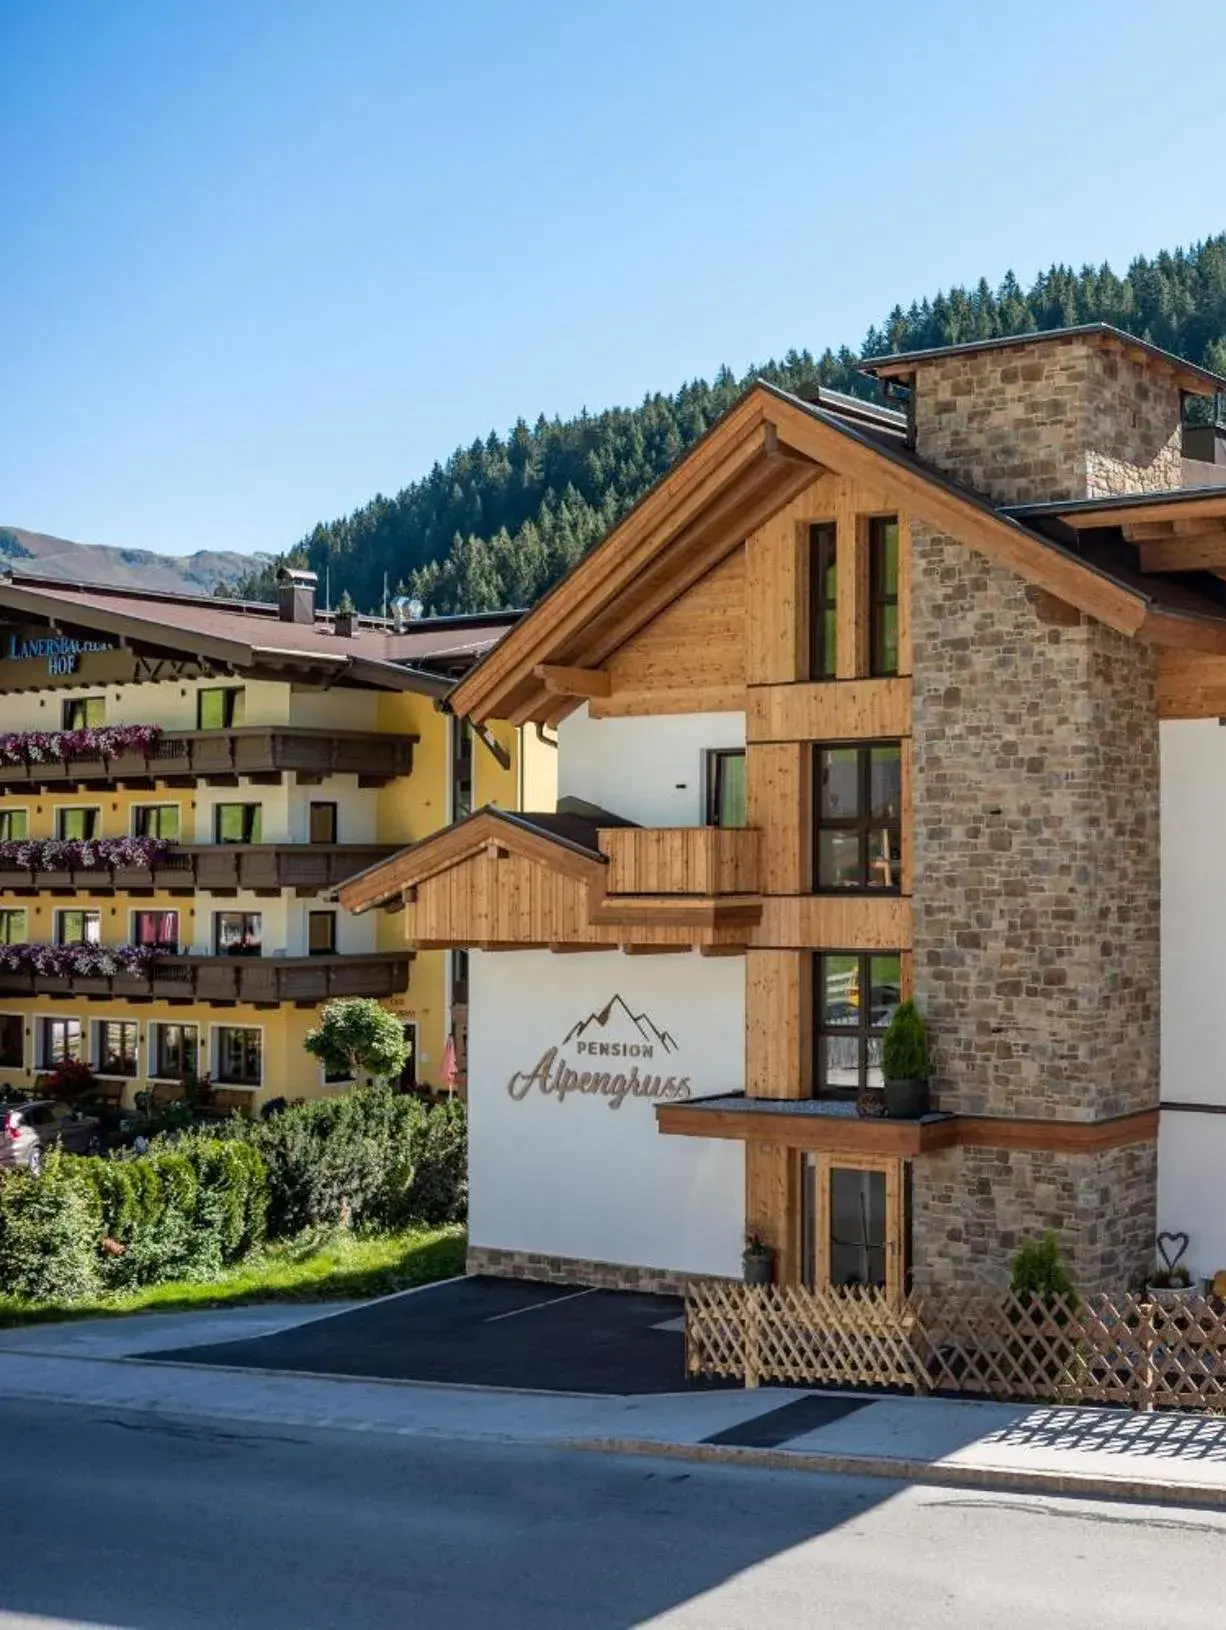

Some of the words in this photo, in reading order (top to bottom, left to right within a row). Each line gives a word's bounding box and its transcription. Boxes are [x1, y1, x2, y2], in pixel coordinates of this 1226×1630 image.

[48, 655, 76, 676] HOF
[577, 1041, 653, 1058] PENSION
[507, 1046, 691, 1110] Alpengruss
